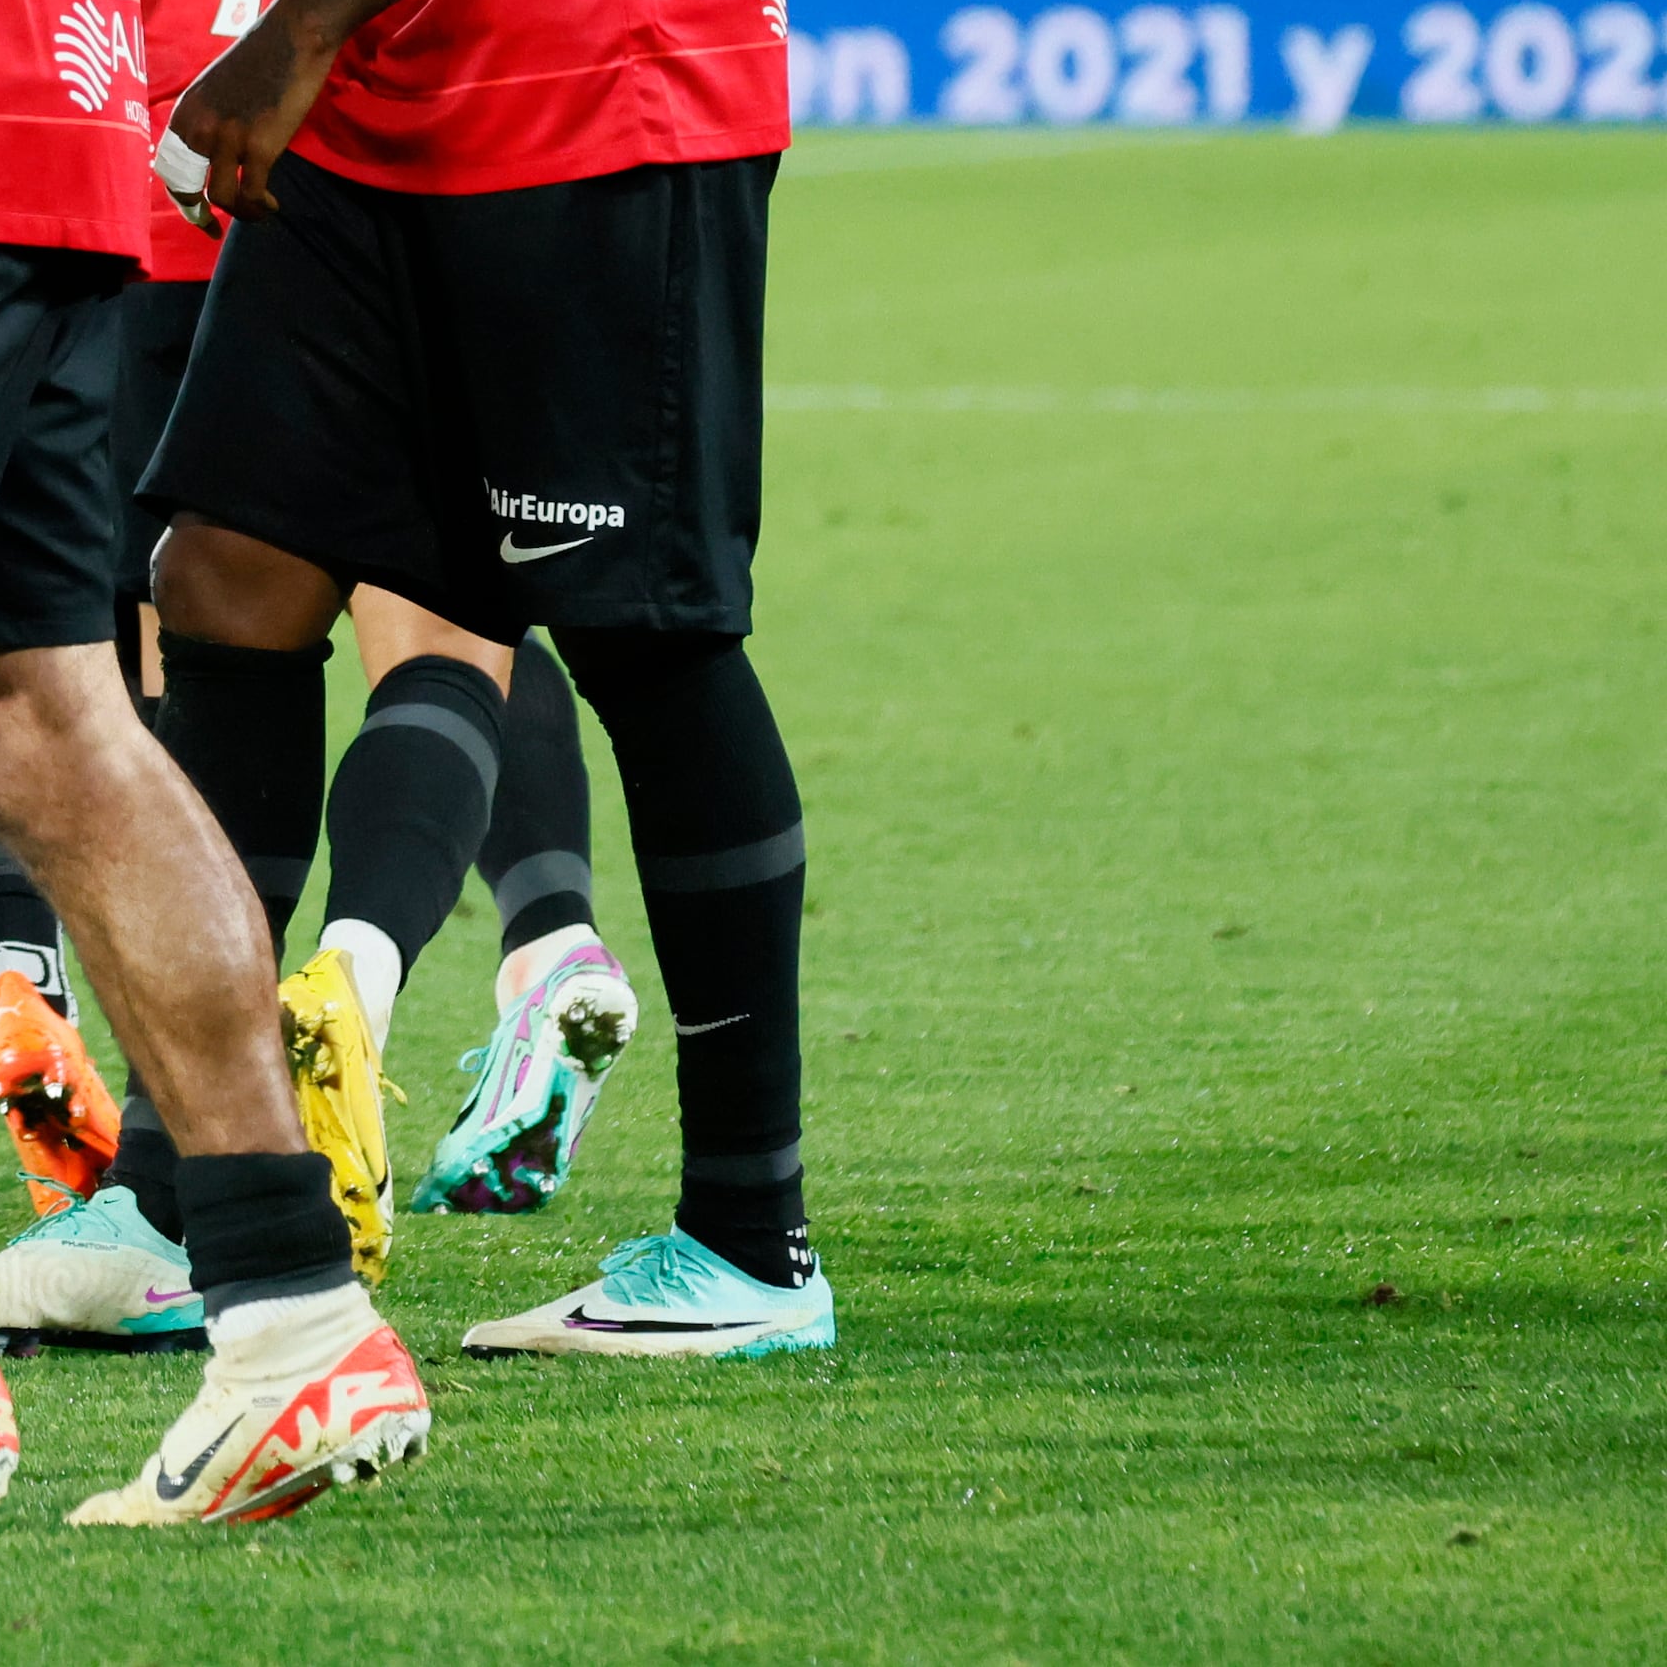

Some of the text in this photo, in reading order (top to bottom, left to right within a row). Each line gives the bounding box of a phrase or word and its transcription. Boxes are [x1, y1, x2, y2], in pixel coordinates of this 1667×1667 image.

[939, 4, 1253, 125] 2021
[1281, 25, 1375, 133] y
[1400, 1, 1667, 123] 202
[489, 487, 625, 530] AirEuropa
